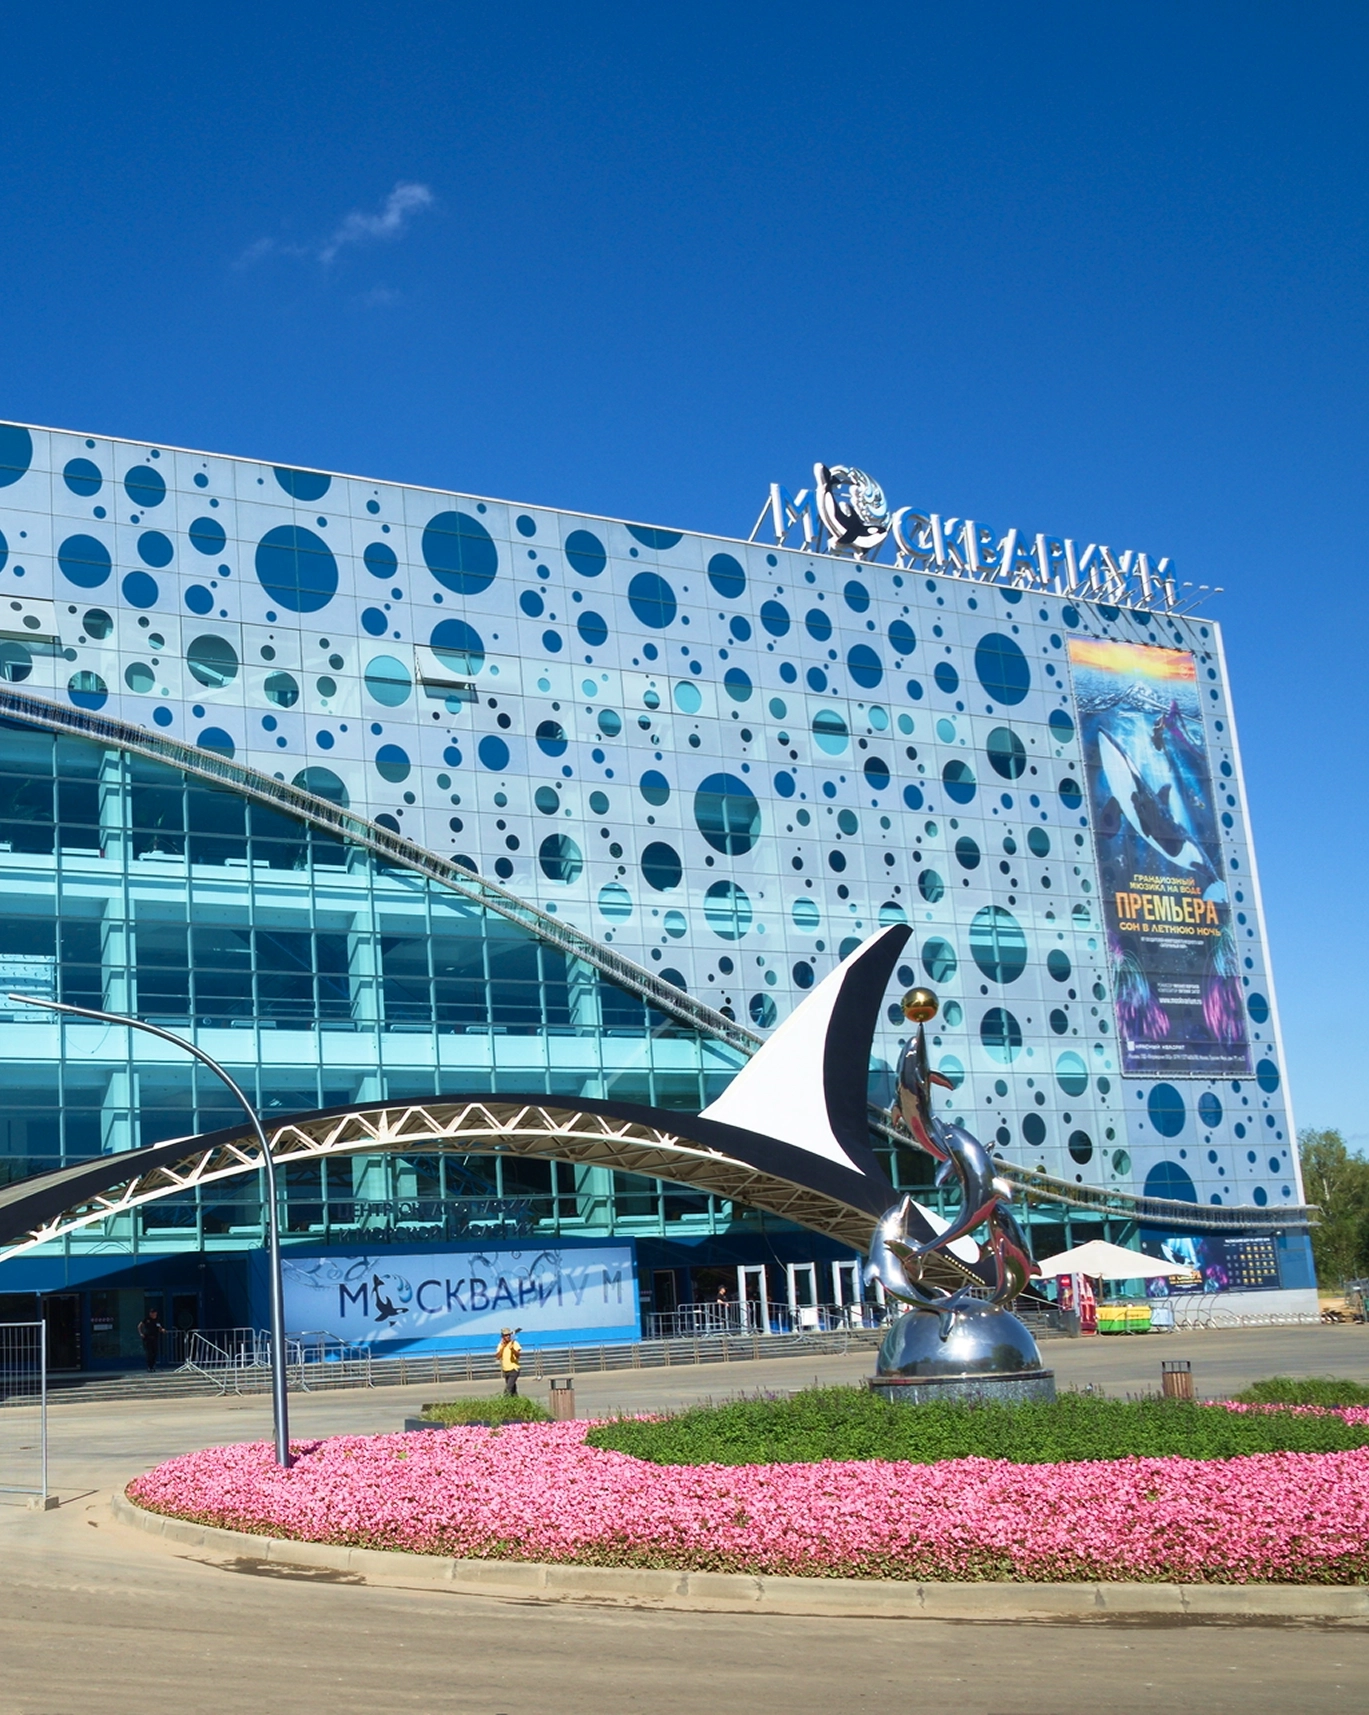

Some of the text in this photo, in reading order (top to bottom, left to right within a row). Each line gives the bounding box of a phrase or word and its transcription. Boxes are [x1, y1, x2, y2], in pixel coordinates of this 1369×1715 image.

[1133, 874, 1196, 885] ГРАНДИОЗНЫЙ
[1129, 882, 1202, 895] МЮЗИКЛ НА ВОДЕ
[1115, 892, 1219, 925] ПРЕМЬЕРА
[1119, 922, 1222, 937] СОН В ЛЕТНЮЮ НОЧЬ
